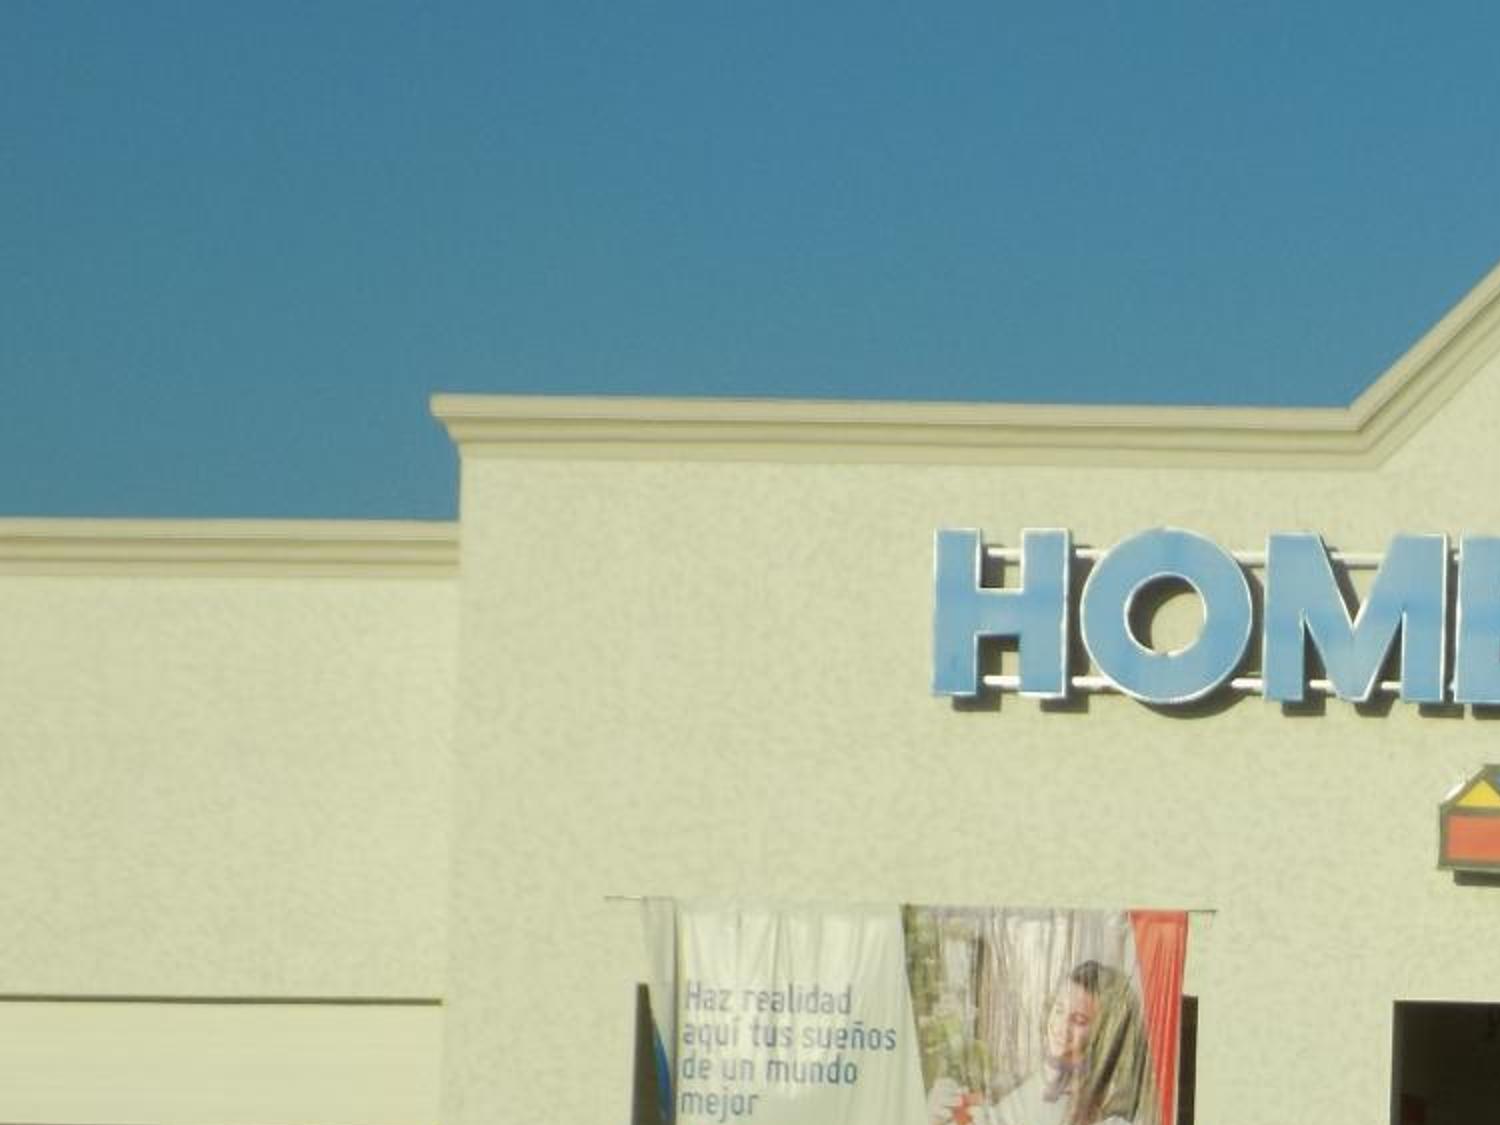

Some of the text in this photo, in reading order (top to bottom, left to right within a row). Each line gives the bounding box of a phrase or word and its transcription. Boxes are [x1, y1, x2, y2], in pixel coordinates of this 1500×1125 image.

[684, 980, 852, 1015] Haz realidad
[683, 1016, 897, 1052] aquí tus sueños
[682, 1055, 857, 1085] de un mundo
[681, 1087, 758, 1122] mejor
